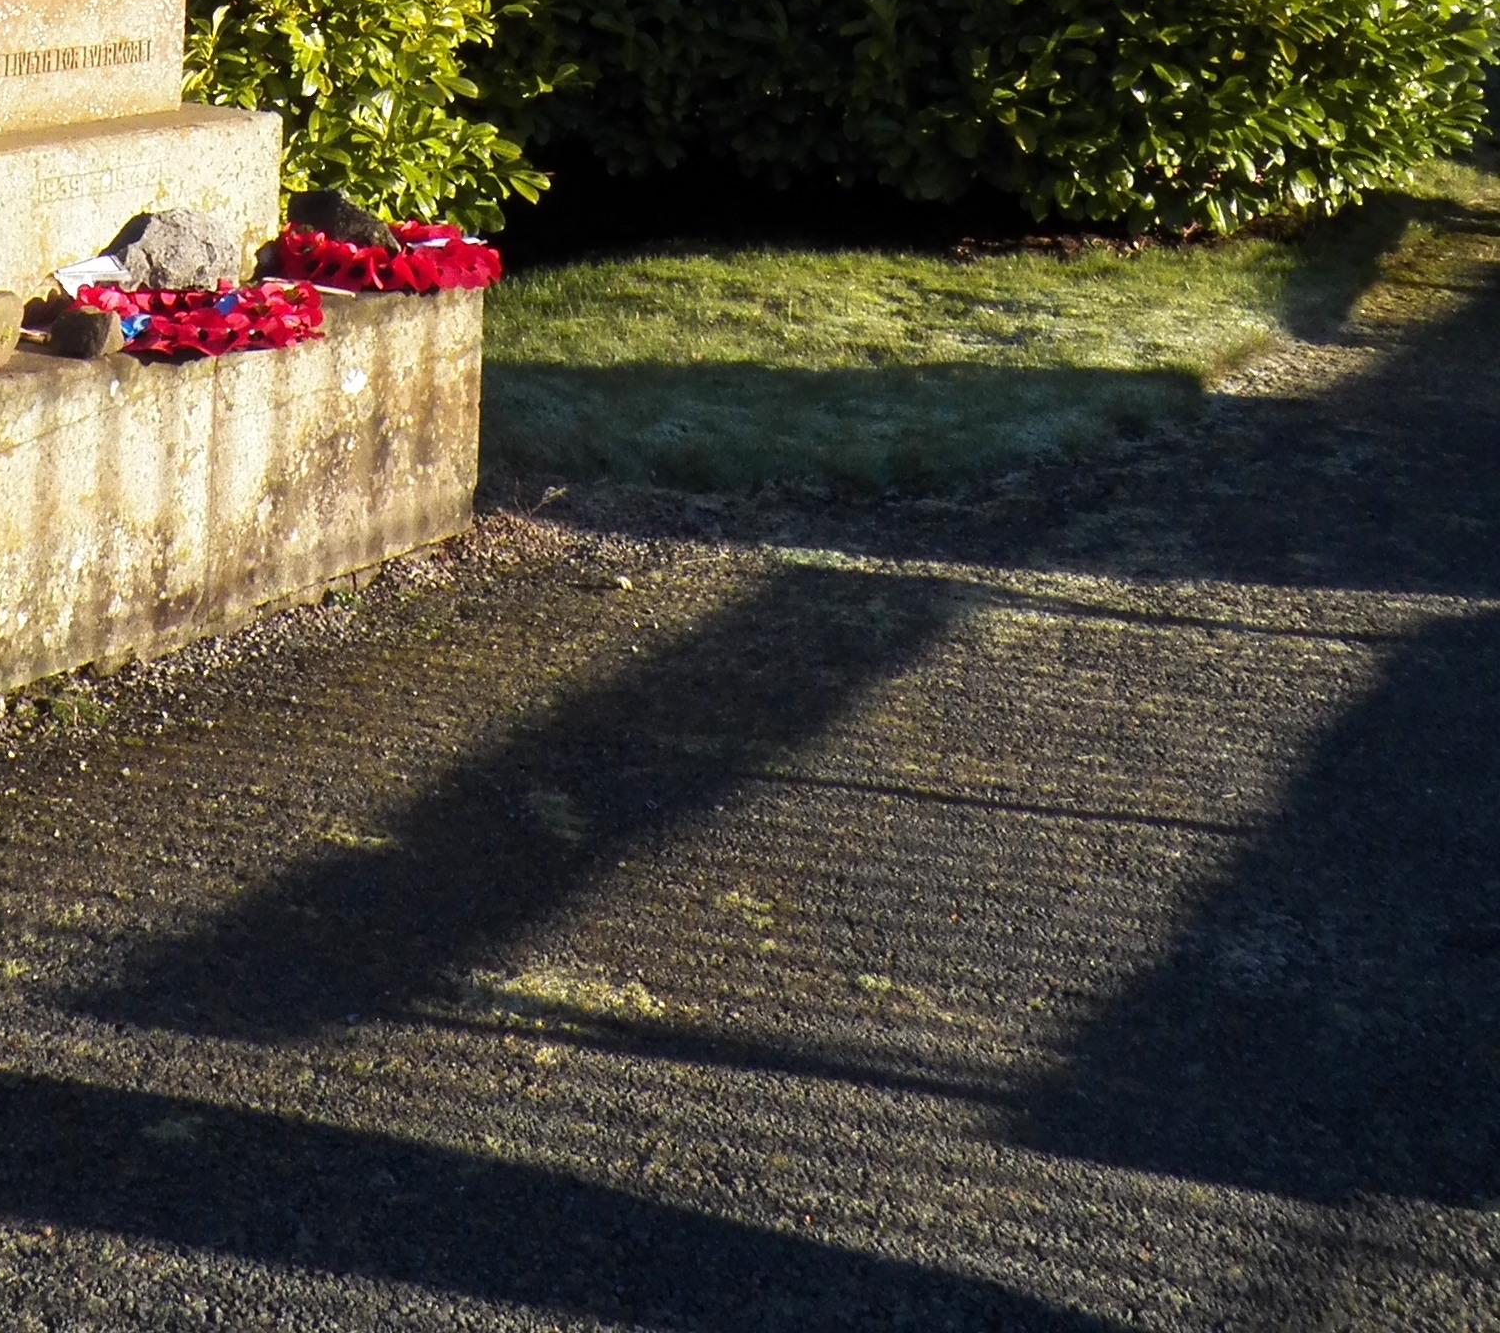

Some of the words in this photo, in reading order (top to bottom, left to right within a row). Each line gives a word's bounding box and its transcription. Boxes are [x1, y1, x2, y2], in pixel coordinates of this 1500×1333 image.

[4, 48, 52, 77] LIVETH
[54, 45, 81, 71] FOR
[82, 39, 152, 68] EVERMORE
